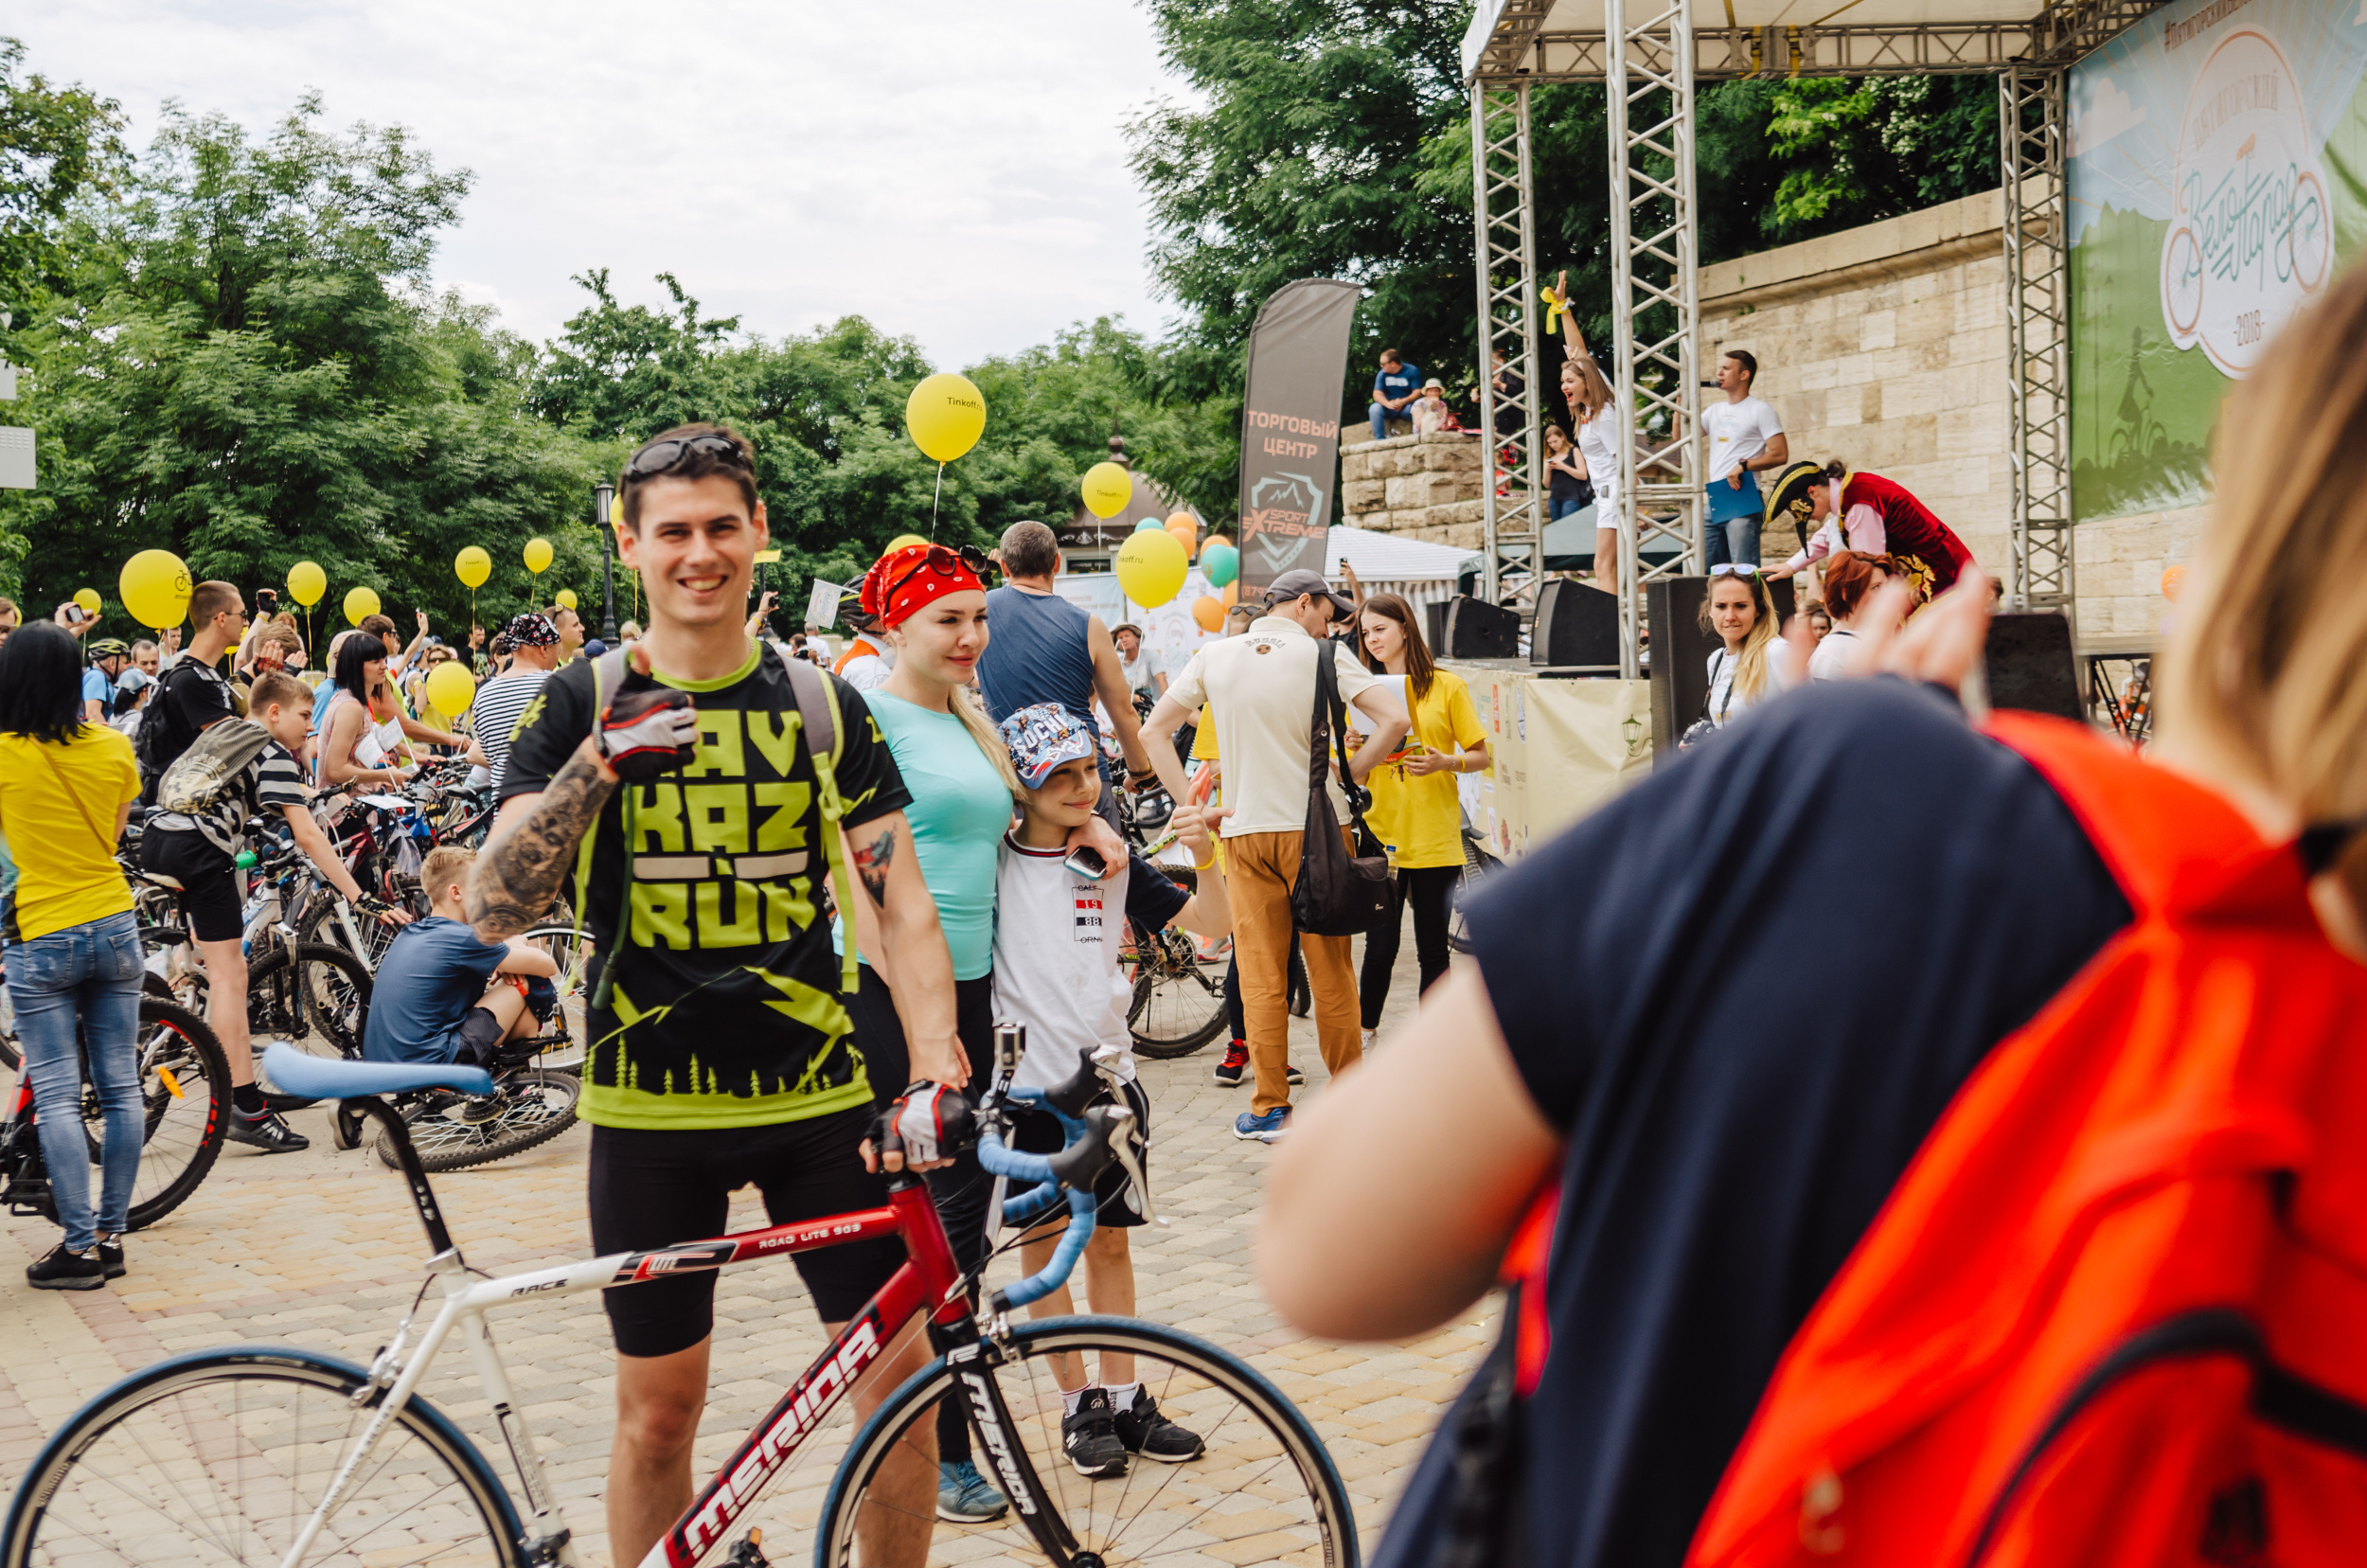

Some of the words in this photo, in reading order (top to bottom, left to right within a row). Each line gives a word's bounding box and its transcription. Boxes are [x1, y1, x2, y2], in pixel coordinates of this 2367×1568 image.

[1248, 410, 1337, 439] ТОРГОВЫЙ
[1264, 437, 1318, 459] ЦЕНТР
[1270, 509, 1309, 524] SPORT
[1117, 555, 1144, 564] inkoff.ru
[661, 710, 803, 777] AV
[1013, 713, 1069, 757] SOCHI
[622, 782, 811, 853] KAZ
[631, 876, 817, 950] RUN
[1085, 900, 1098, 909] 19
[1085, 917, 1099, 926] 88
[758, 1236, 794, 1249] ROAD
[800, 1229, 830, 1241] LITE
[833, 1223, 862, 1236] 903
[510, 1278, 568, 1297] RACE
[684, 1322, 881, 1560] MERIDA
[961, 1372, 1039, 1515] MERIDA
